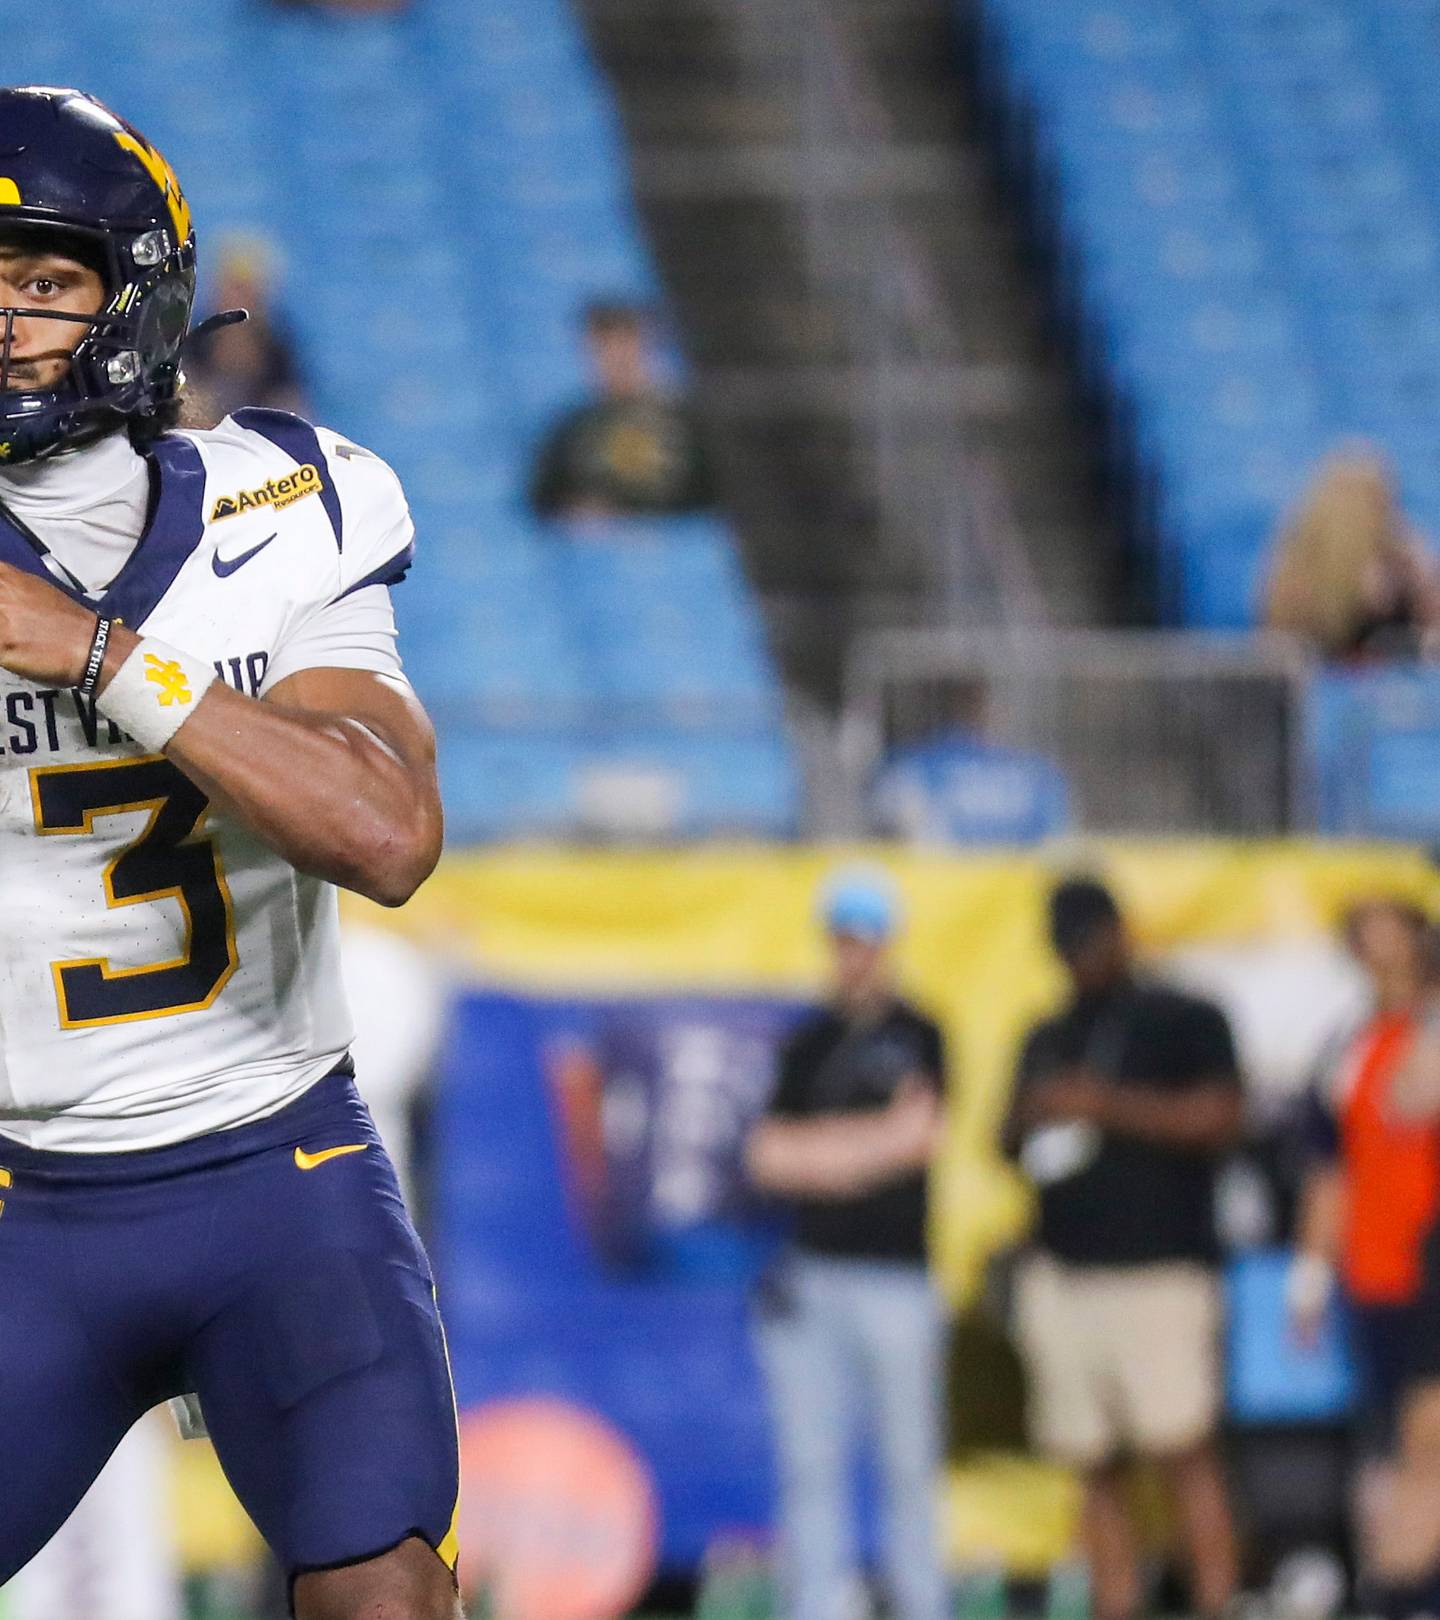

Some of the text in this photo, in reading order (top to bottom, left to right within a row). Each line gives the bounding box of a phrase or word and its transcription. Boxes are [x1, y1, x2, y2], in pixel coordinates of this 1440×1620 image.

[239, 466, 314, 512] Antero
[94, 619, 110, 649] STACK
[86, 649, 103, 677] THE
[28, 753, 239, 1030] 3
